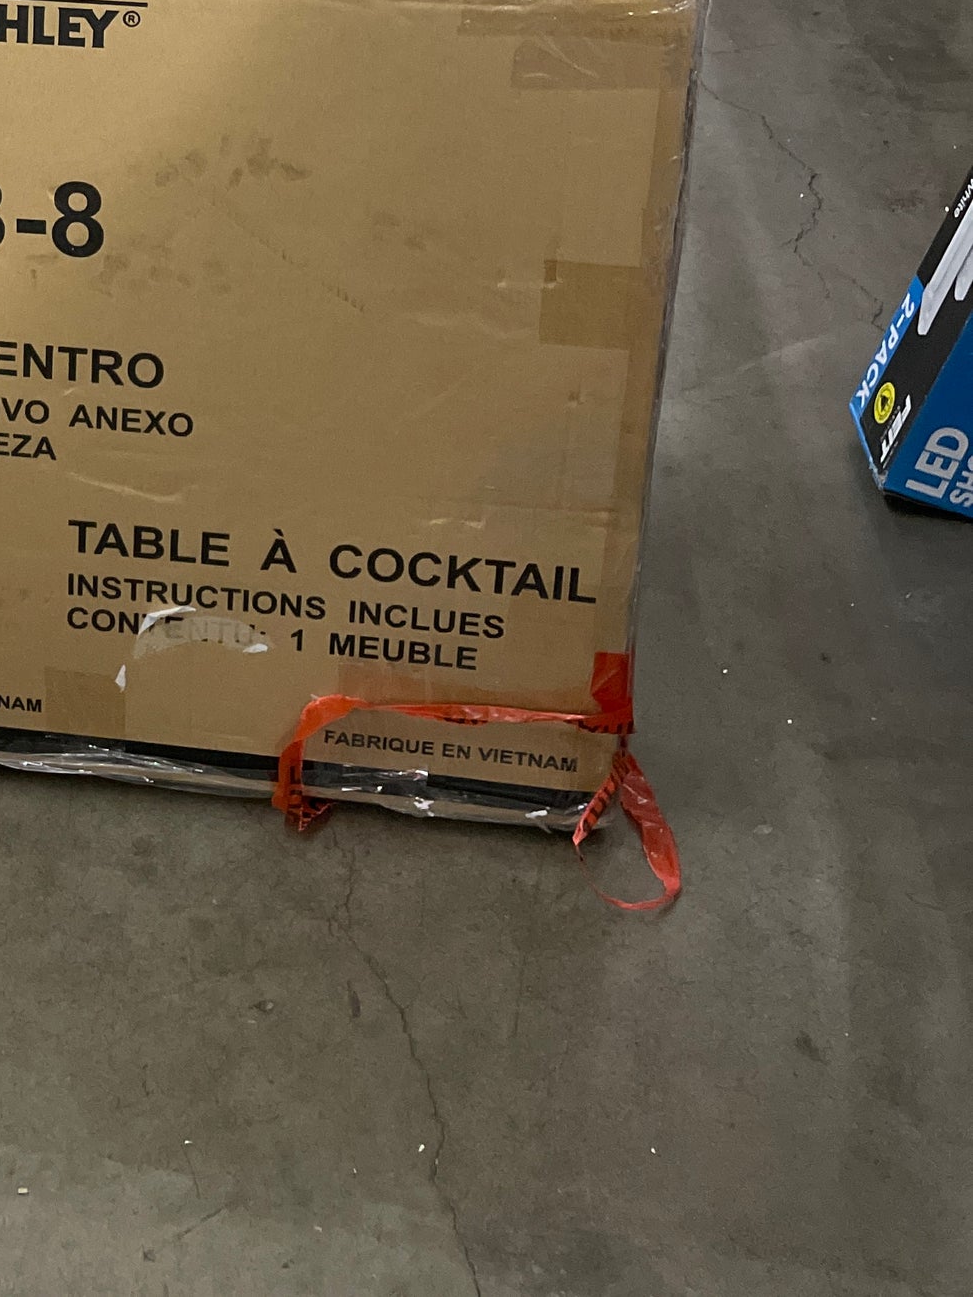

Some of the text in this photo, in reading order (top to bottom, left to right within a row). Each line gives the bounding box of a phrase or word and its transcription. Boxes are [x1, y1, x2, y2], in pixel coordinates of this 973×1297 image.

[856, 292, 915, 408] 2-PACK
[69, 404, 193, 437] ANEXO
[905, 427, 969, 499] LED
[68, 520, 597, 604] TABLE À COCKTAIL
[68, 573, 504, 640] INSTRUCTIONS INCLUES
[291, 630, 304, 652] 1
[329, 633, 477, 670] MEUBLE
[323, 730, 579, 774] FABRIQUE EN VIETNAM
